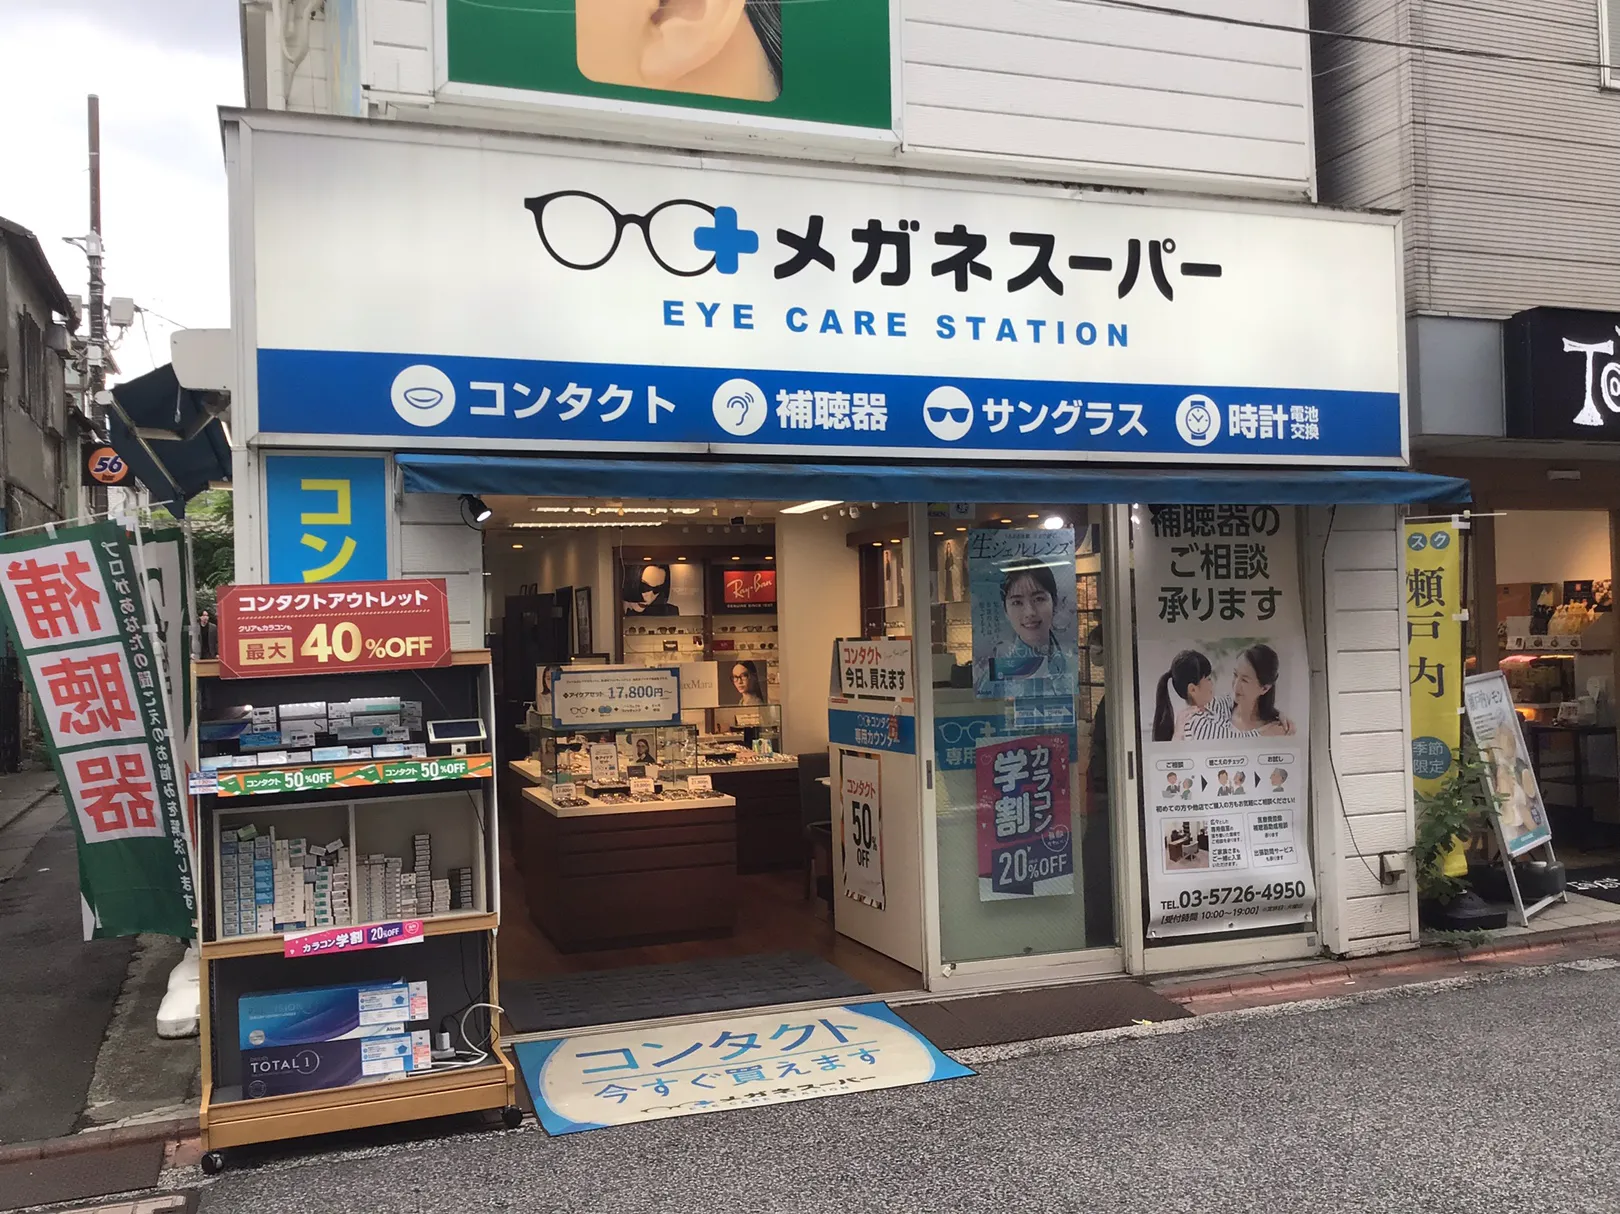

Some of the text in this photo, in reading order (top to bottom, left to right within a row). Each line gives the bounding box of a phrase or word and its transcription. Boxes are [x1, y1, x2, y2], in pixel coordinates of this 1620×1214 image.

[774, 214, 1222, 301] メガネスーパー
[662, 299, 1129, 348] EYE CARE STATION
[469, 380, 676, 424] コンタクト
[775, 389, 888, 433] 補聴器
[981, 397, 1149, 437] サングラス
[1228, 402, 1289, 440] 時計
[93, 456, 123, 473] 56
[1150, 504, 1280, 537] 補聴器の
[969, 531, 1074, 560] 生ジェルレンズ
[1170, 542, 1270, 580] ご相談
[238, 589, 429, 612] コンタクトアウトレット
[1158, 586, 1282, 623] 承ります
[237, 624, 293, 633] クリアもカラコンも
[245, 642, 288, 661] 最大
[843, 646, 882, 666] コンタクト
[1412, 741, 1445, 758] 季節
[385, 766, 418, 777] コンタクト
[1412, 758, 1445, 774] 限定
[246, 777, 281, 788] コンタクト
[847, 778, 876, 798] コンタクト
[993, 748, 1030, 838] 学割
[1030, 745, 1053, 833] カラコン
[856, 848, 870, 869] OFF
[575, 1018, 858, 1074] コンタクト
[250, 1057, 299, 1073] TOTAL
[594, 1047, 880, 1104] 今すぐ買えます
